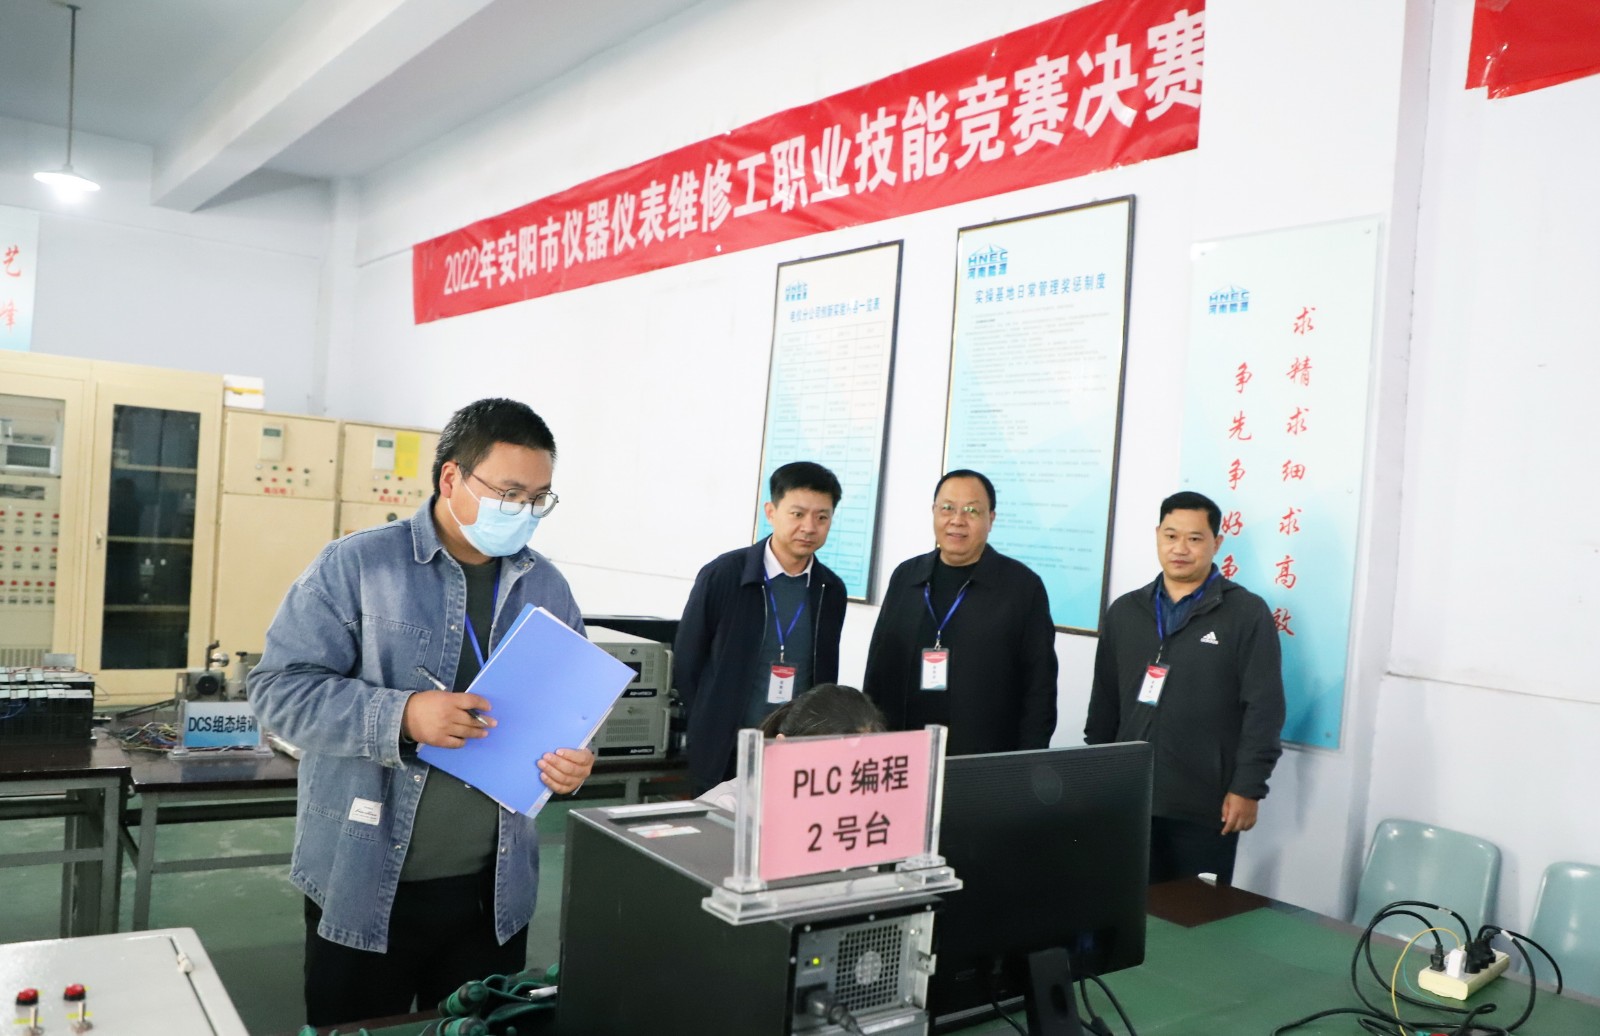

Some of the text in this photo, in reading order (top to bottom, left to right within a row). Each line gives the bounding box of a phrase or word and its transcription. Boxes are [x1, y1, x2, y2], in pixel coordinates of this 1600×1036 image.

[444, 9, 1205, 295] 2022年安阳市仪器仪表维修工职业技能竞赛决赛
[793, 755, 909, 799] PLC 编程
[807, 811, 891, 852] 2 号台
